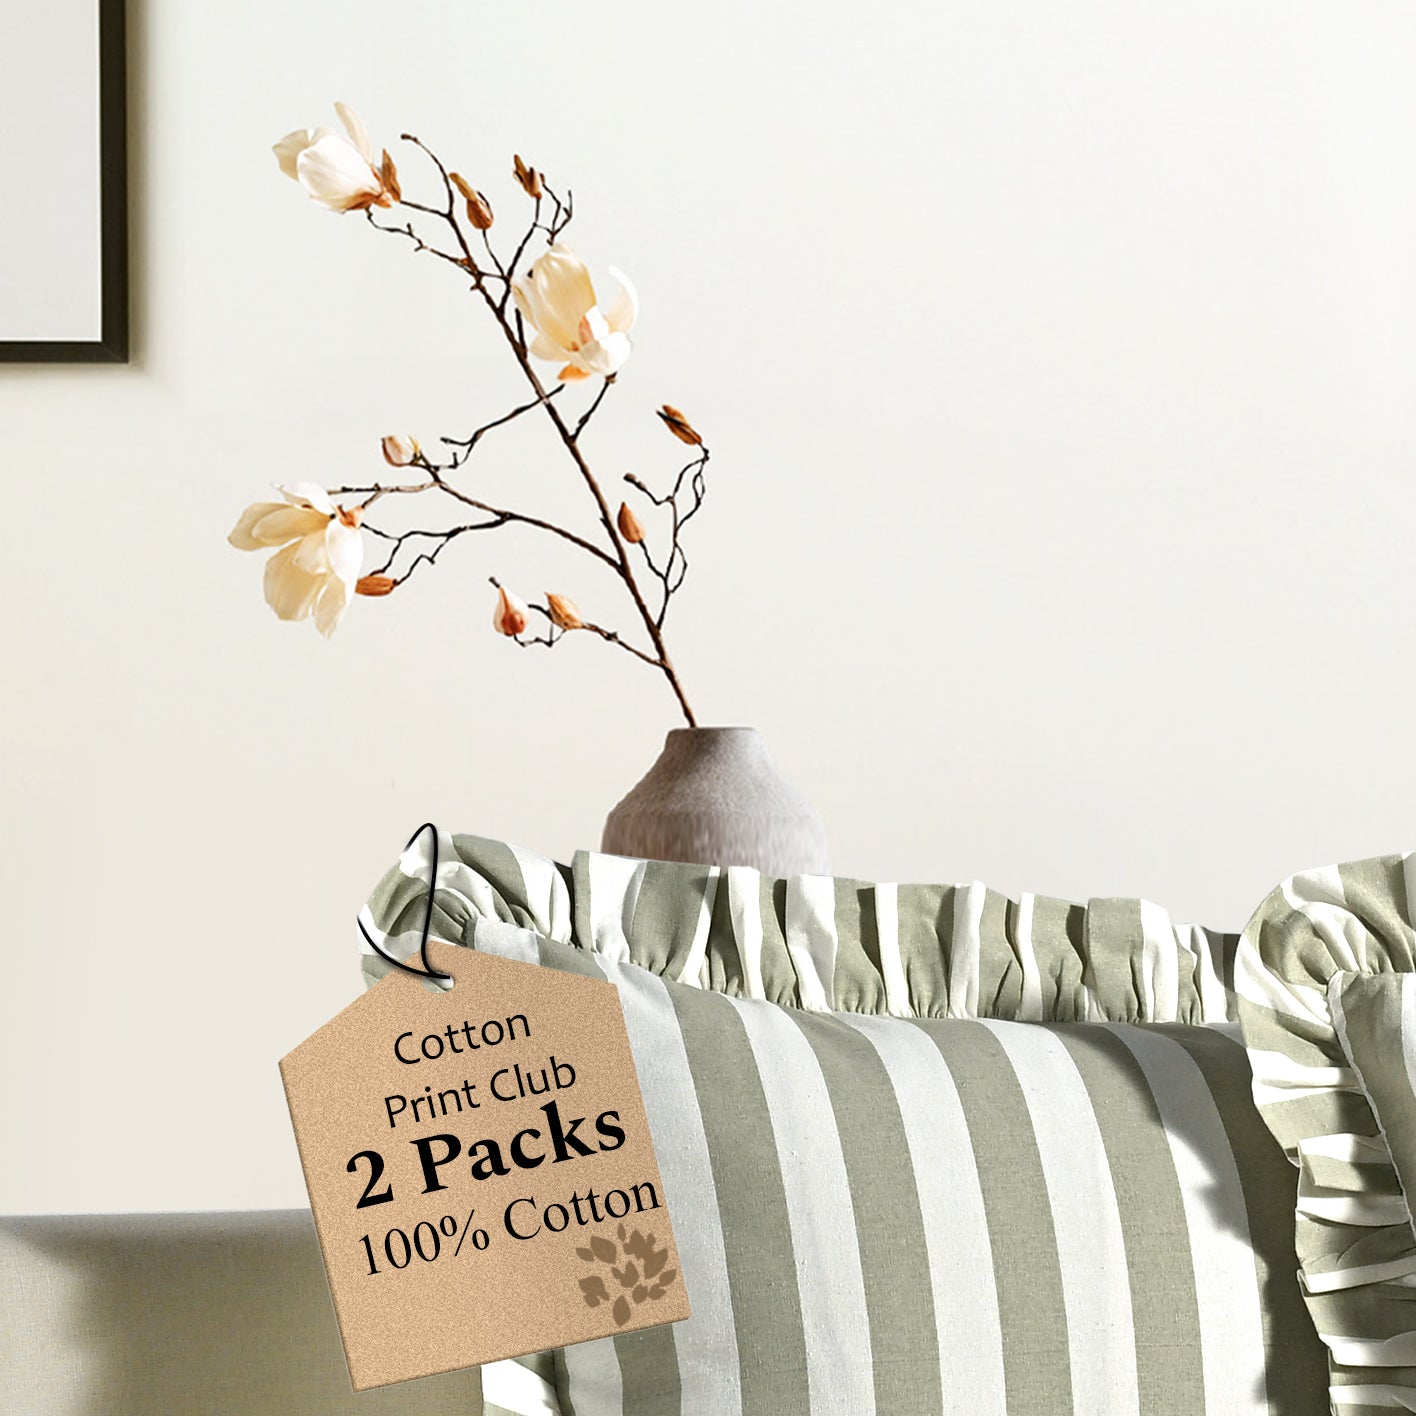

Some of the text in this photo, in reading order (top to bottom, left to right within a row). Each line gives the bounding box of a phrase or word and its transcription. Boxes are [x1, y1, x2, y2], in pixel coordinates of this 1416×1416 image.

[394, 1014, 531, 1065] Cotton
[384, 1055, 577, 1129] Print Club
[346, 1099, 626, 1210] 2 Packs
[358, 1181, 661, 1276] 100% Cotton
